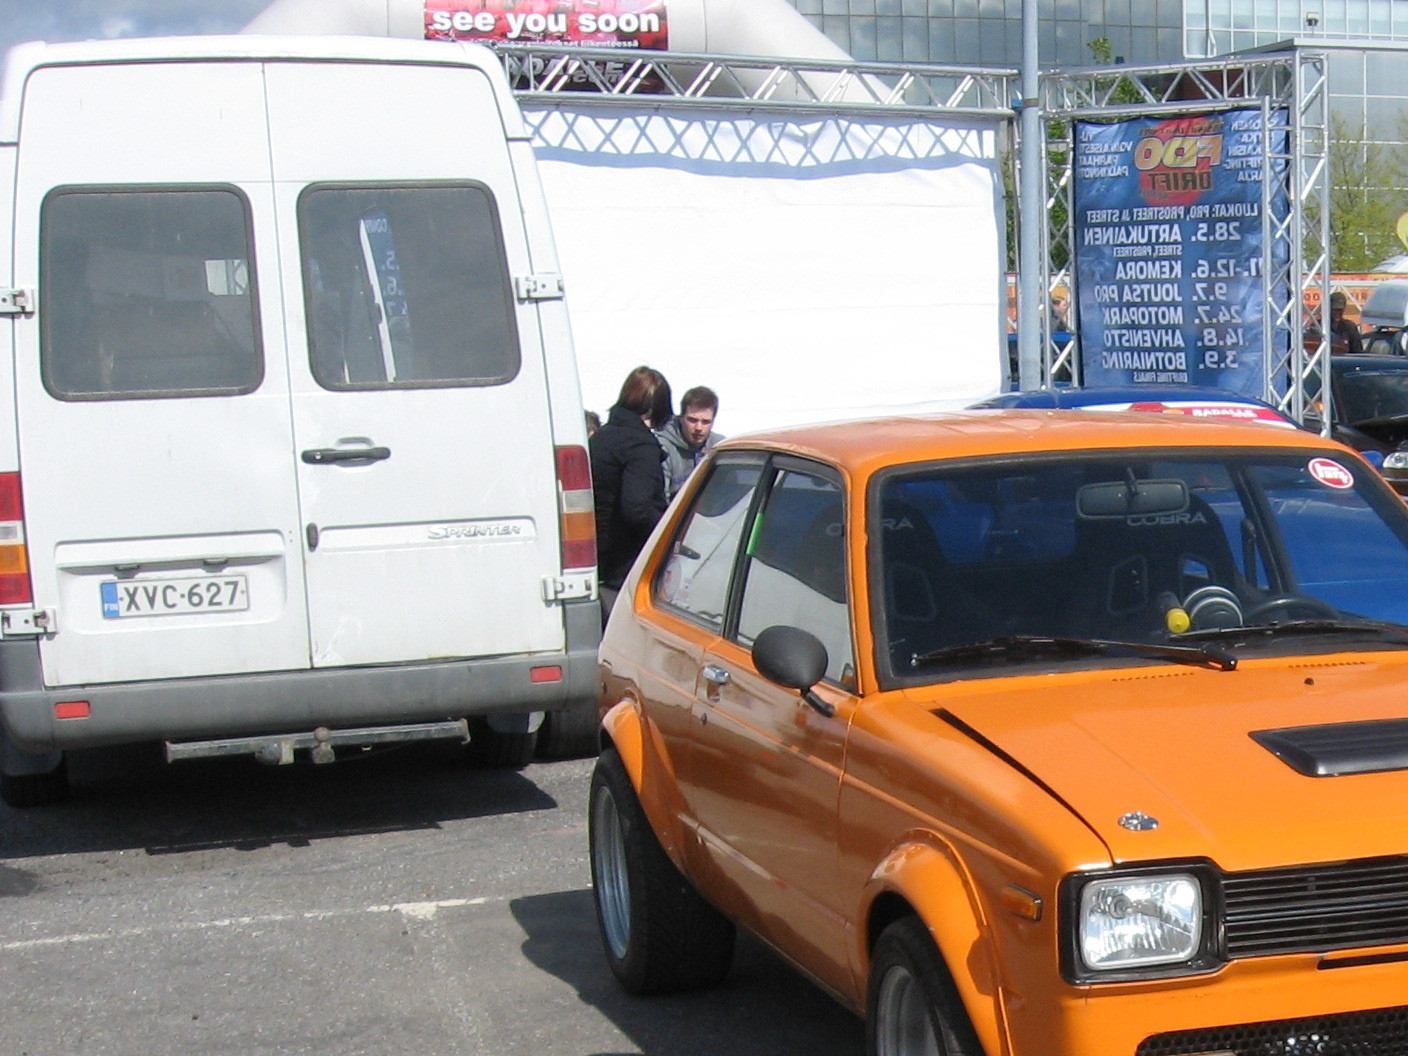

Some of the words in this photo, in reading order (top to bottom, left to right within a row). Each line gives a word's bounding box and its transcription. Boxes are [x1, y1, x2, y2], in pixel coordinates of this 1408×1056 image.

[432, 11, 495, 32] see
[506, 12, 568, 38] you
[578, 12, 661, 33] soon
[123, 580, 239, 612] XVC-627
